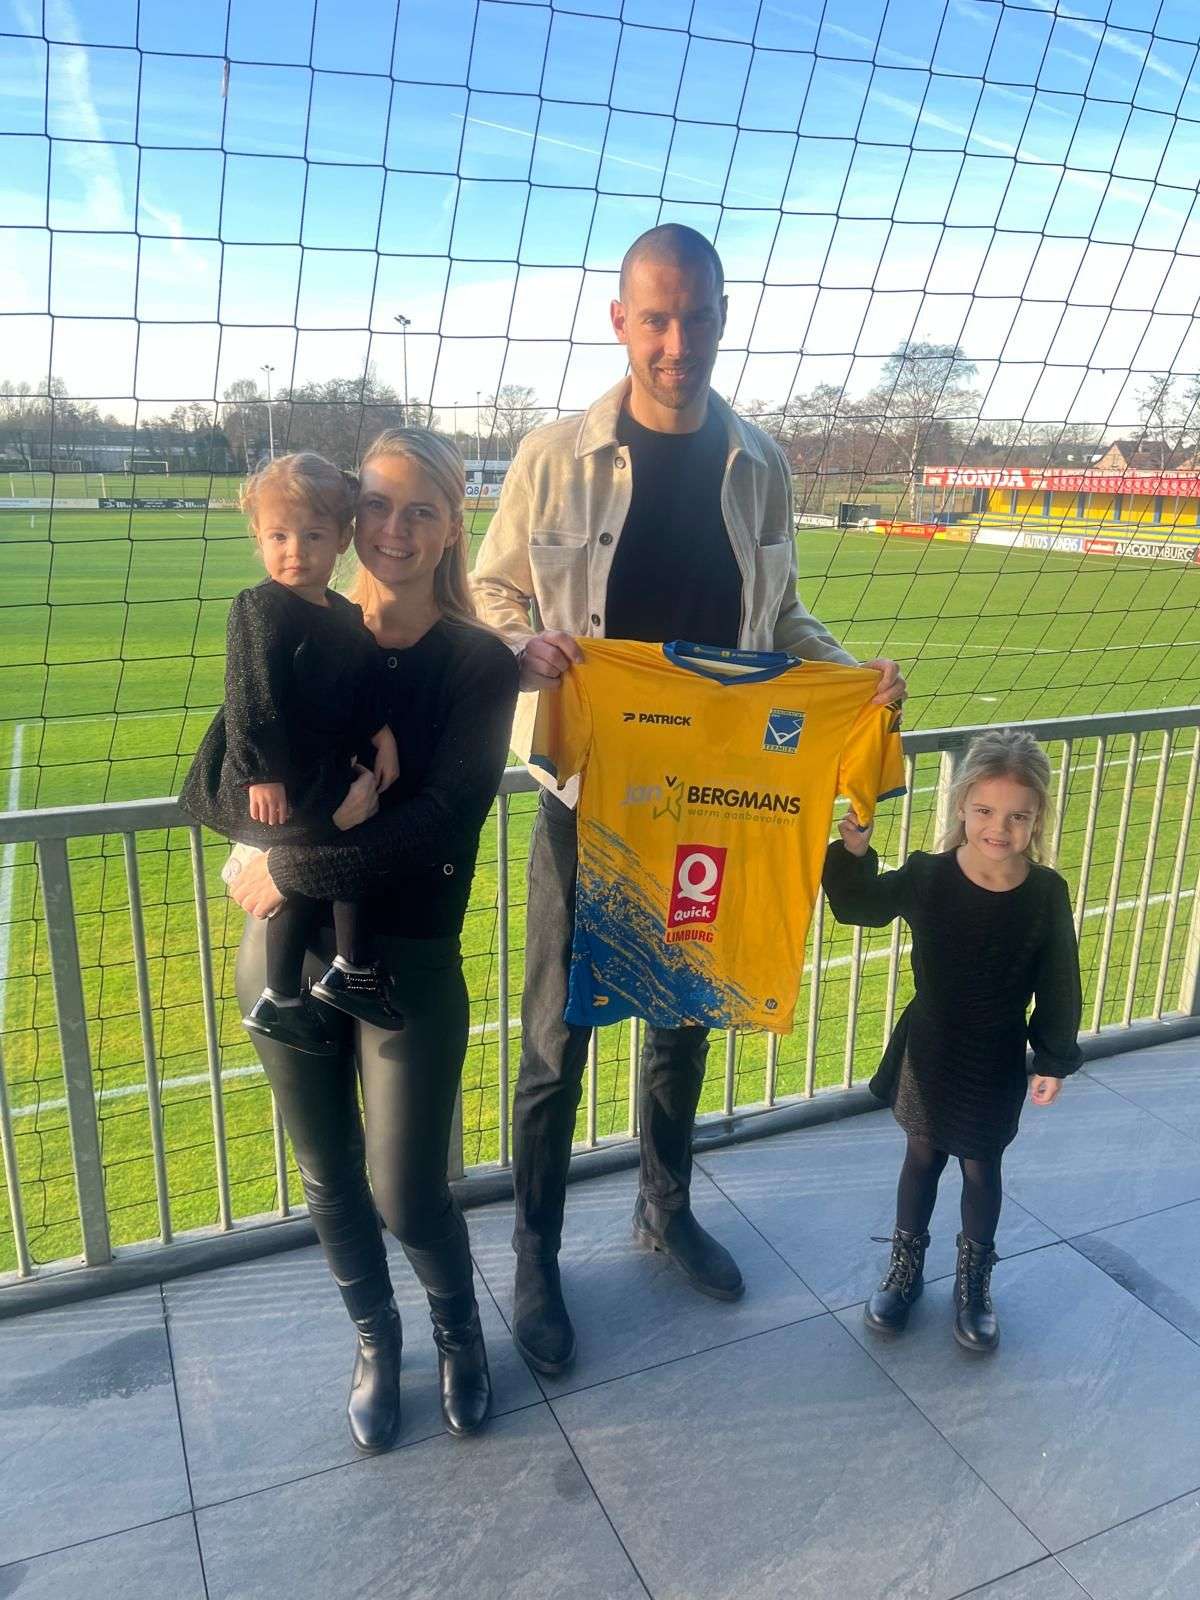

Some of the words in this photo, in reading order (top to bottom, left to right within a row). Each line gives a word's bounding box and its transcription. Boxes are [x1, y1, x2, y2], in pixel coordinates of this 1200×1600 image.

[947, 469, 1025, 487] HONDA
[466, 486, 479, 495] Q8
[640, 713, 691, 726] PATRICK
[687, 786, 801, 814] BERGMANS
[687, 808, 719, 819] warm
[674, 906, 711, 921] Quick
[666, 929, 714, 943] LIMBURG
